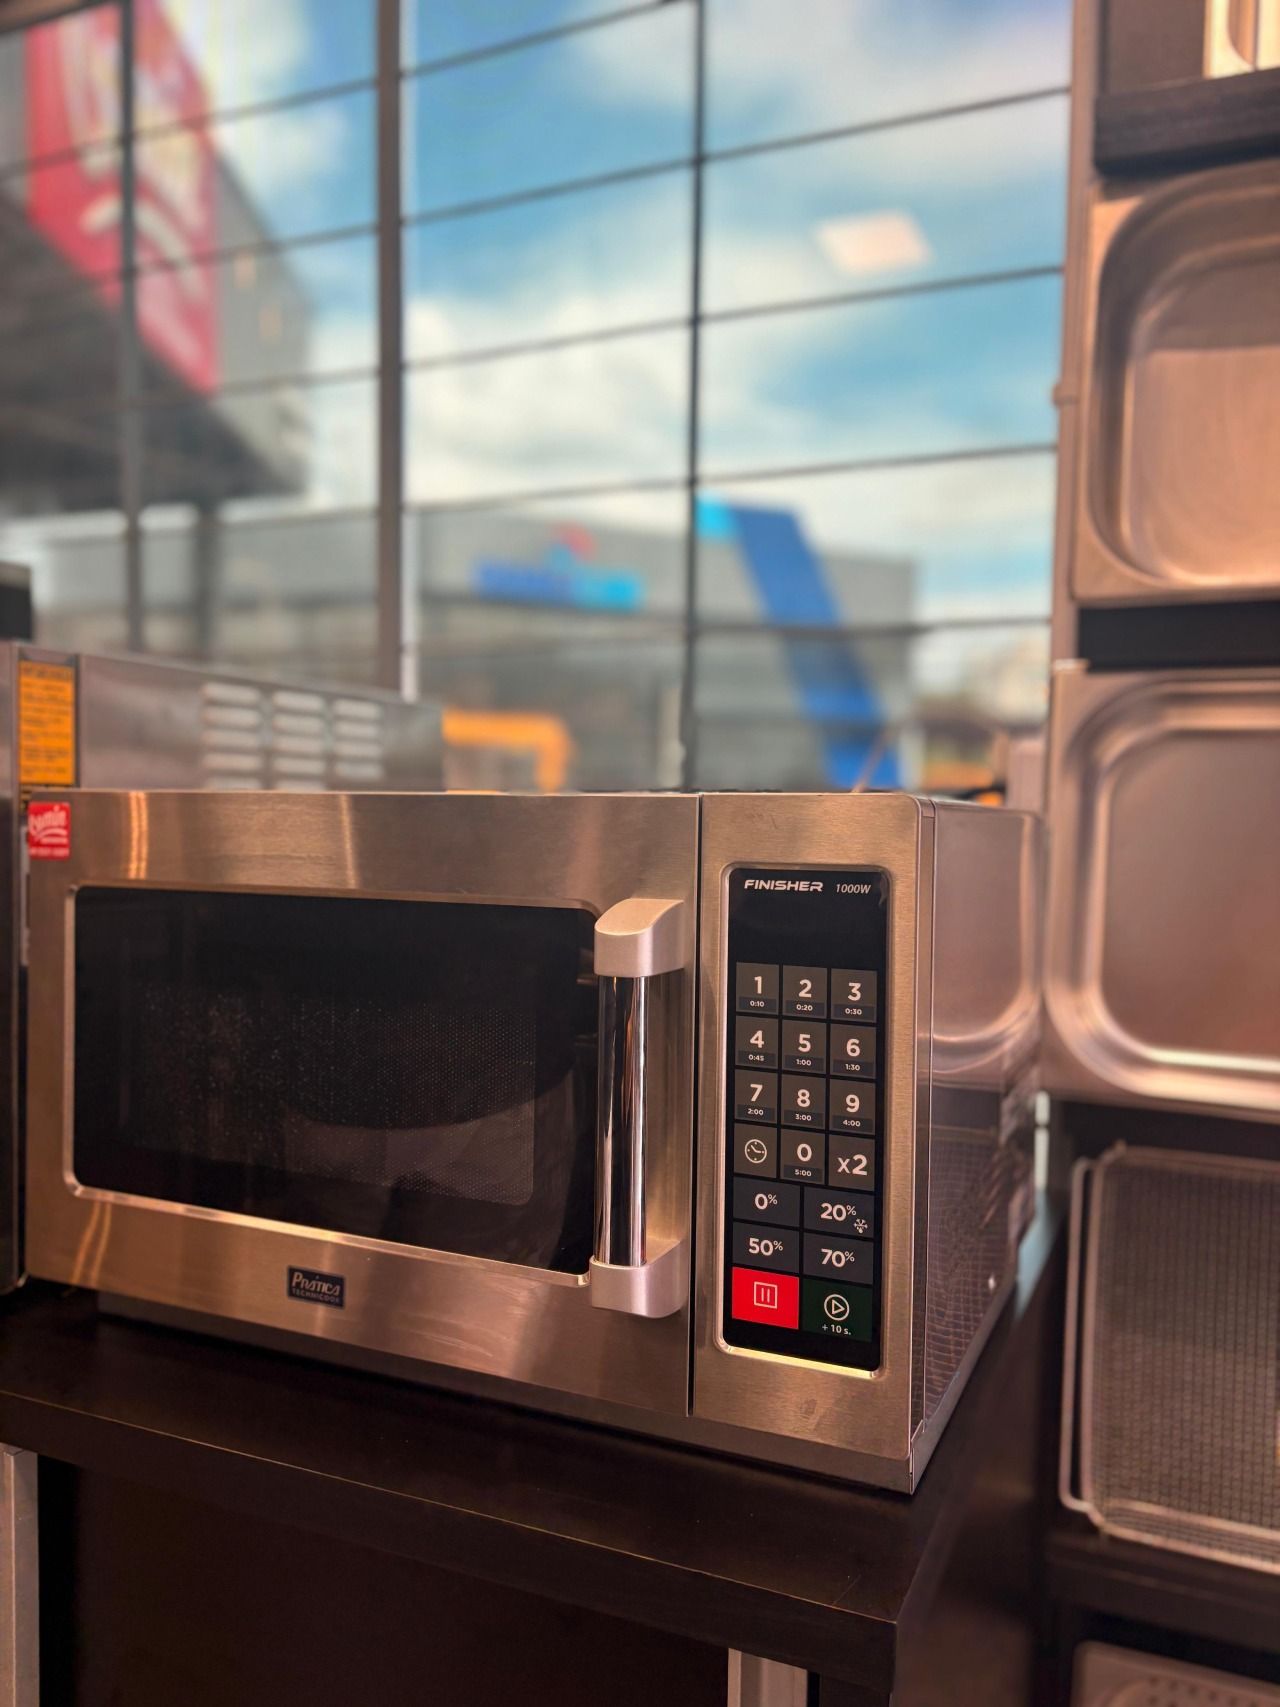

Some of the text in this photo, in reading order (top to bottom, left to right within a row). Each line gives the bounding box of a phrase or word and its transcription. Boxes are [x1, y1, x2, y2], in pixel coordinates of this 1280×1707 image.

[743, 879, 872, 894] FINISHER 1000W
[754, 975, 763, 994] 1
[798, 978, 812, 998] 2
[847, 982, 862, 1002] 3
[749, 1000, 765, 1008] 0:10
[796, 1003, 814, 1012] 0:20
[844, 1007, 863, 1016] 0:30
[749, 1030, 765, 1049] 4
[797, 1033, 812, 1053] 5
[846, 1038, 861, 1057] 6
[748, 1054, 765, 1062] 0:45
[796, 1058, 812, 1066] 1:00
[845, 1063, 861, 1071] 1:30
[750, 1083, 763, 1102] 7
[796, 1088, 811, 1108] 8
[747, 1108, 764, 1116] 2:00
[845, 1094, 860, 1113] 9
[795, 1113, 812, 1122] 3:00
[842, 1119, 861, 1127] 4:00
[796, 1143, 813, 1162] 0
[794, 1168, 812, 1177] 5:00
[754, 1193, 778, 1210] 0%
[820, 1202, 857, 1222] 20%
[748, 1237, 784, 1256] 50%
[821, 1248, 855, 1268] 70%
[830, 1324, 842, 1334] 10
